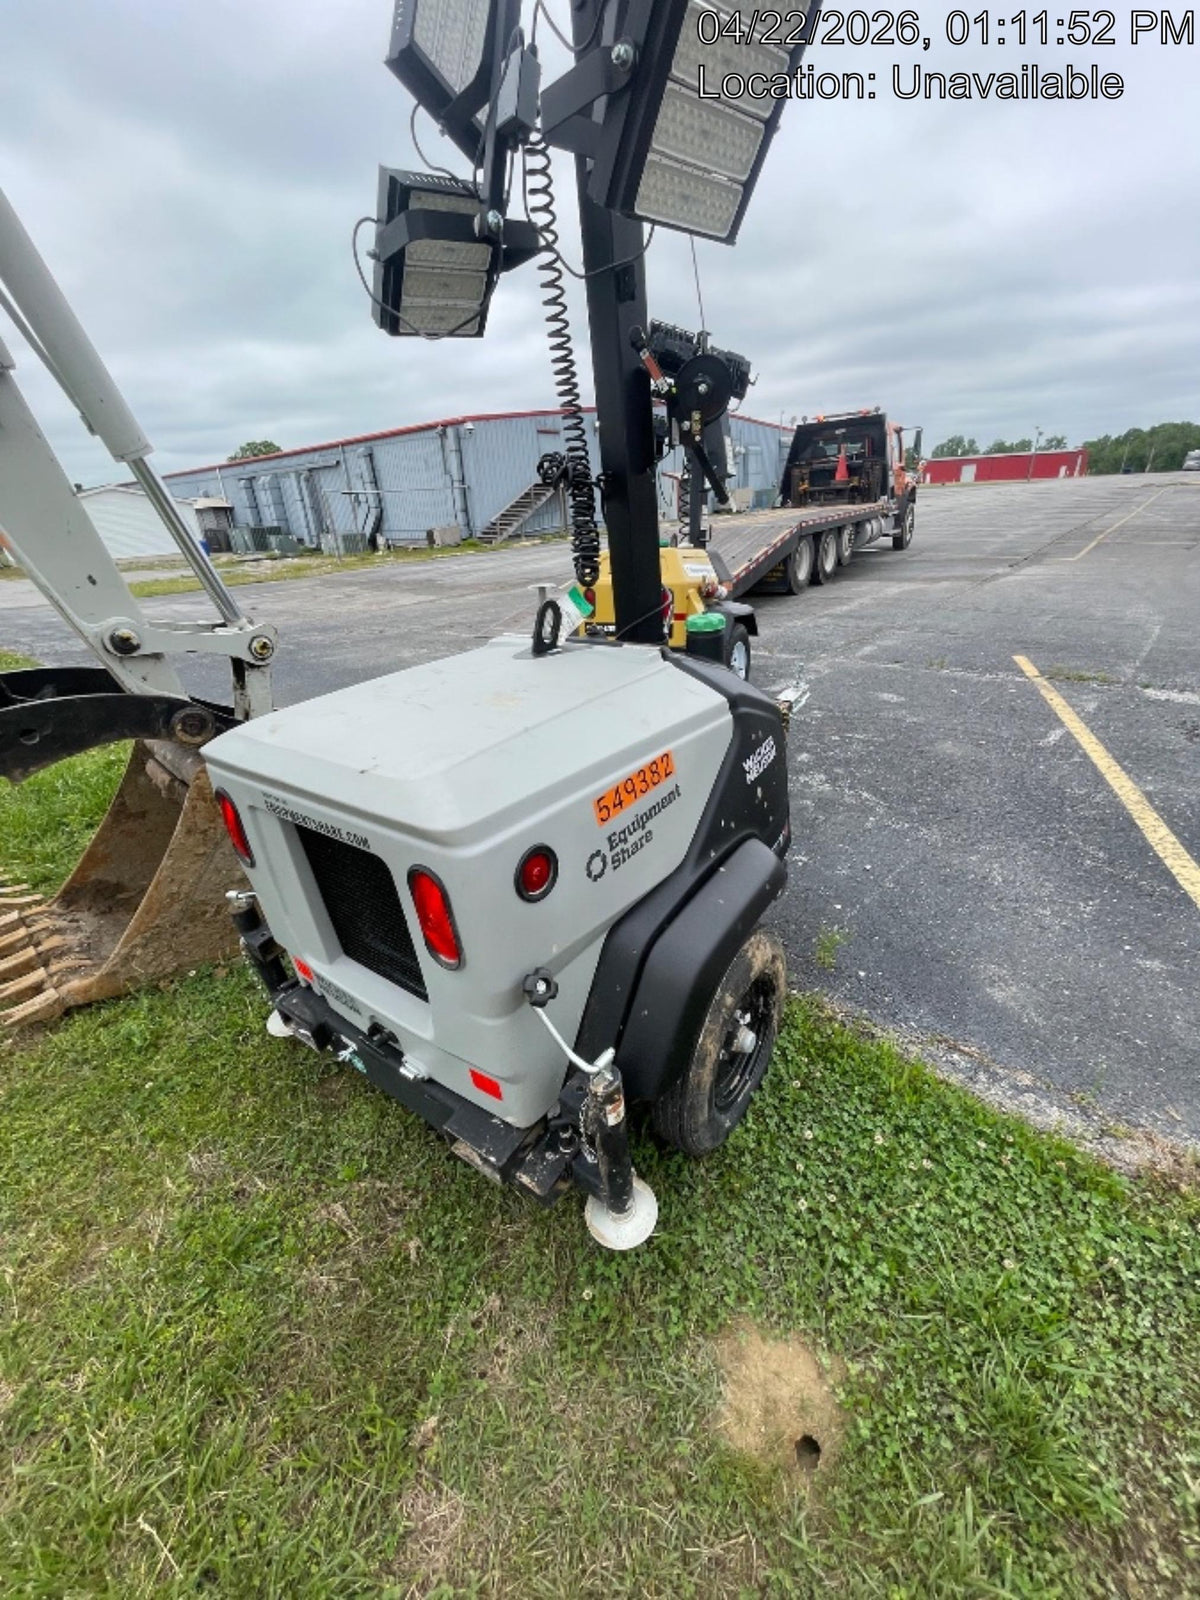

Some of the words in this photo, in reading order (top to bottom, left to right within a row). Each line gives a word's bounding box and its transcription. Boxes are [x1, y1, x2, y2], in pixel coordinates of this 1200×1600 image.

[596, 752, 673, 823] 549382
[606, 783, 682, 851] Equipment
[610, 829, 653, 872] Share
